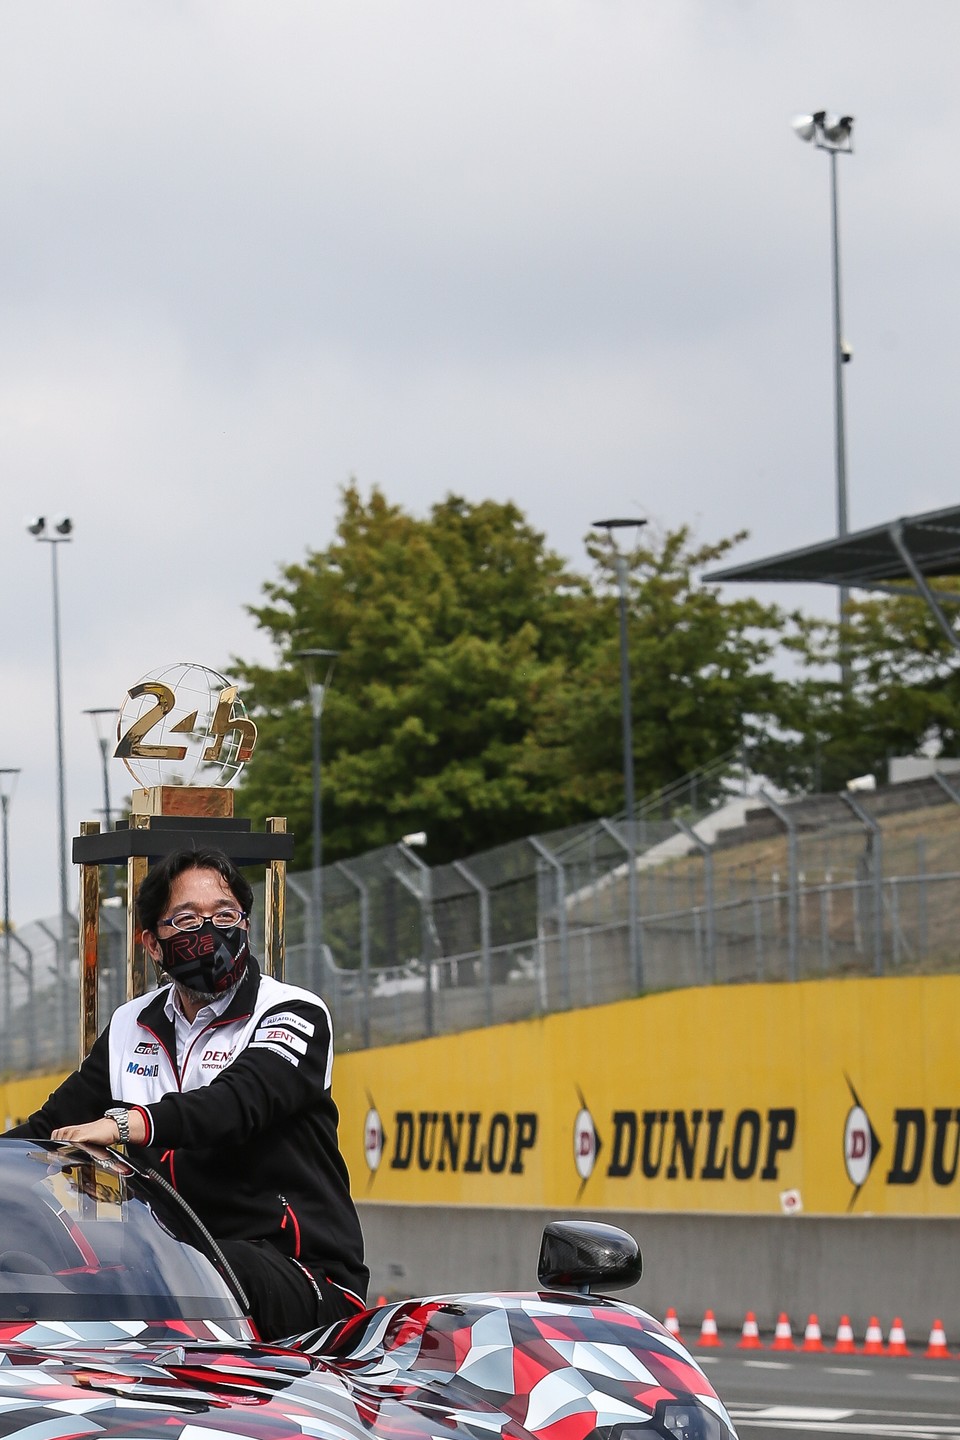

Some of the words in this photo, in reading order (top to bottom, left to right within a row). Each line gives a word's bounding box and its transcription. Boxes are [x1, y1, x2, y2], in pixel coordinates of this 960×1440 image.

[266, 1030, 295, 1043] ZENT
[391, 1111, 538, 1175] DUNLOP
[607, 1107, 796, 1181] DUNLOP
